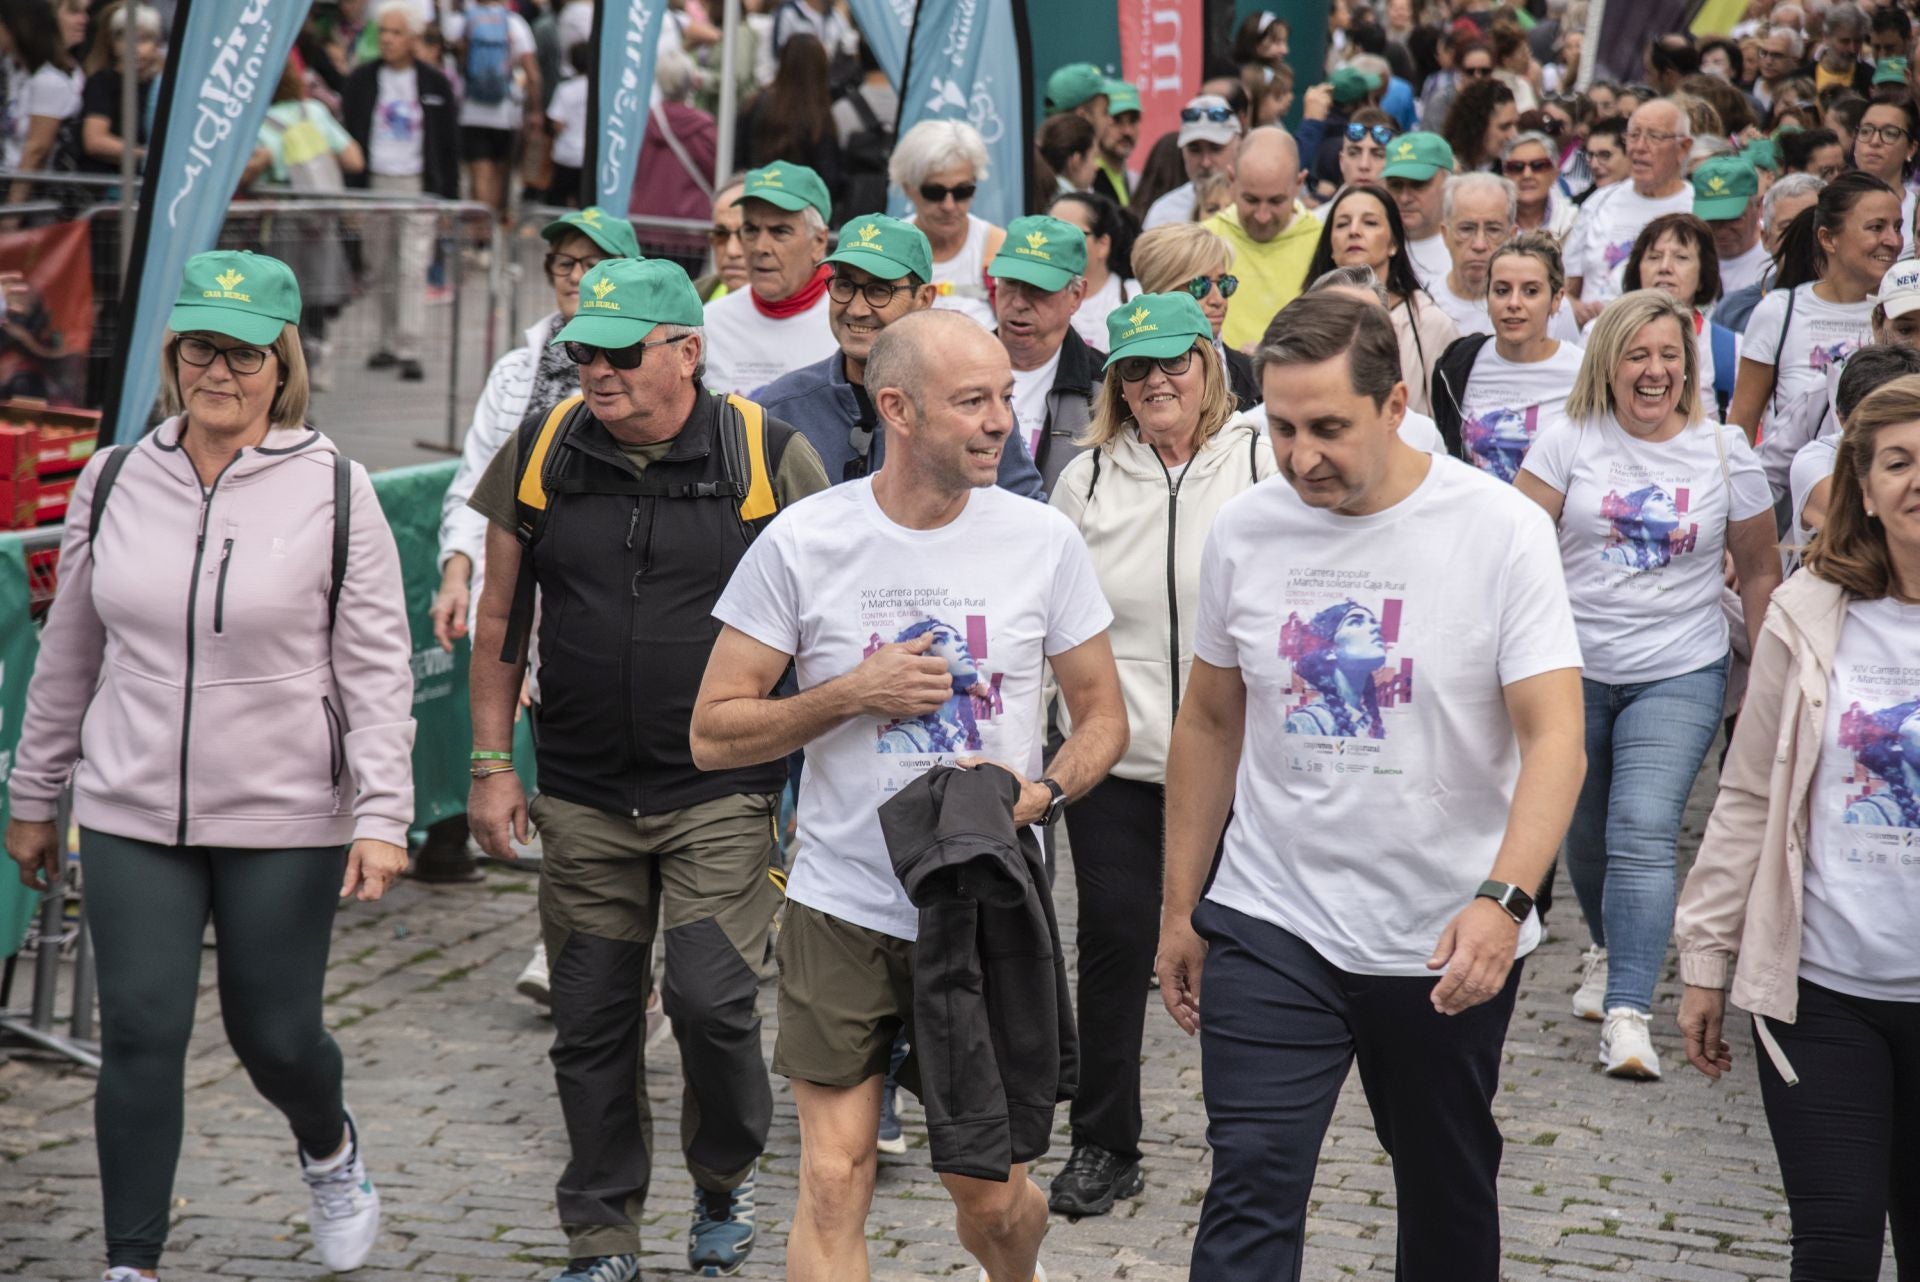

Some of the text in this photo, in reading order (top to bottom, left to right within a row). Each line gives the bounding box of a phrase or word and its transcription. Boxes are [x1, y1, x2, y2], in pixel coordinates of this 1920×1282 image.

[1897, 273, 1919, 286] NEW
[223, 291, 252, 303] RURAL
[596, 300, 621, 311] RURAL
[1135, 323, 1159, 334] RURAL
[1288, 568, 1371, 581] XIV Carrera popular
[1292, 578, 1325, 588] Marcha
[1325, 578, 1362, 589] solidaria
[1363, 580, 1383, 592] Caja
[1384, 581, 1407, 591] Rural
[861, 587, 949, 600] XIV Carrera popular
[861, 597, 986, 611] y Marcha solidaria Caja Rural
[861, 611, 888, 620] CONTRA
[1851, 664, 1868, 674] XIV
[1870, 665, 1901, 675] Carrera
[1856, 675, 1892, 685] Marcha
[899, 759, 931, 769] cajaviva
